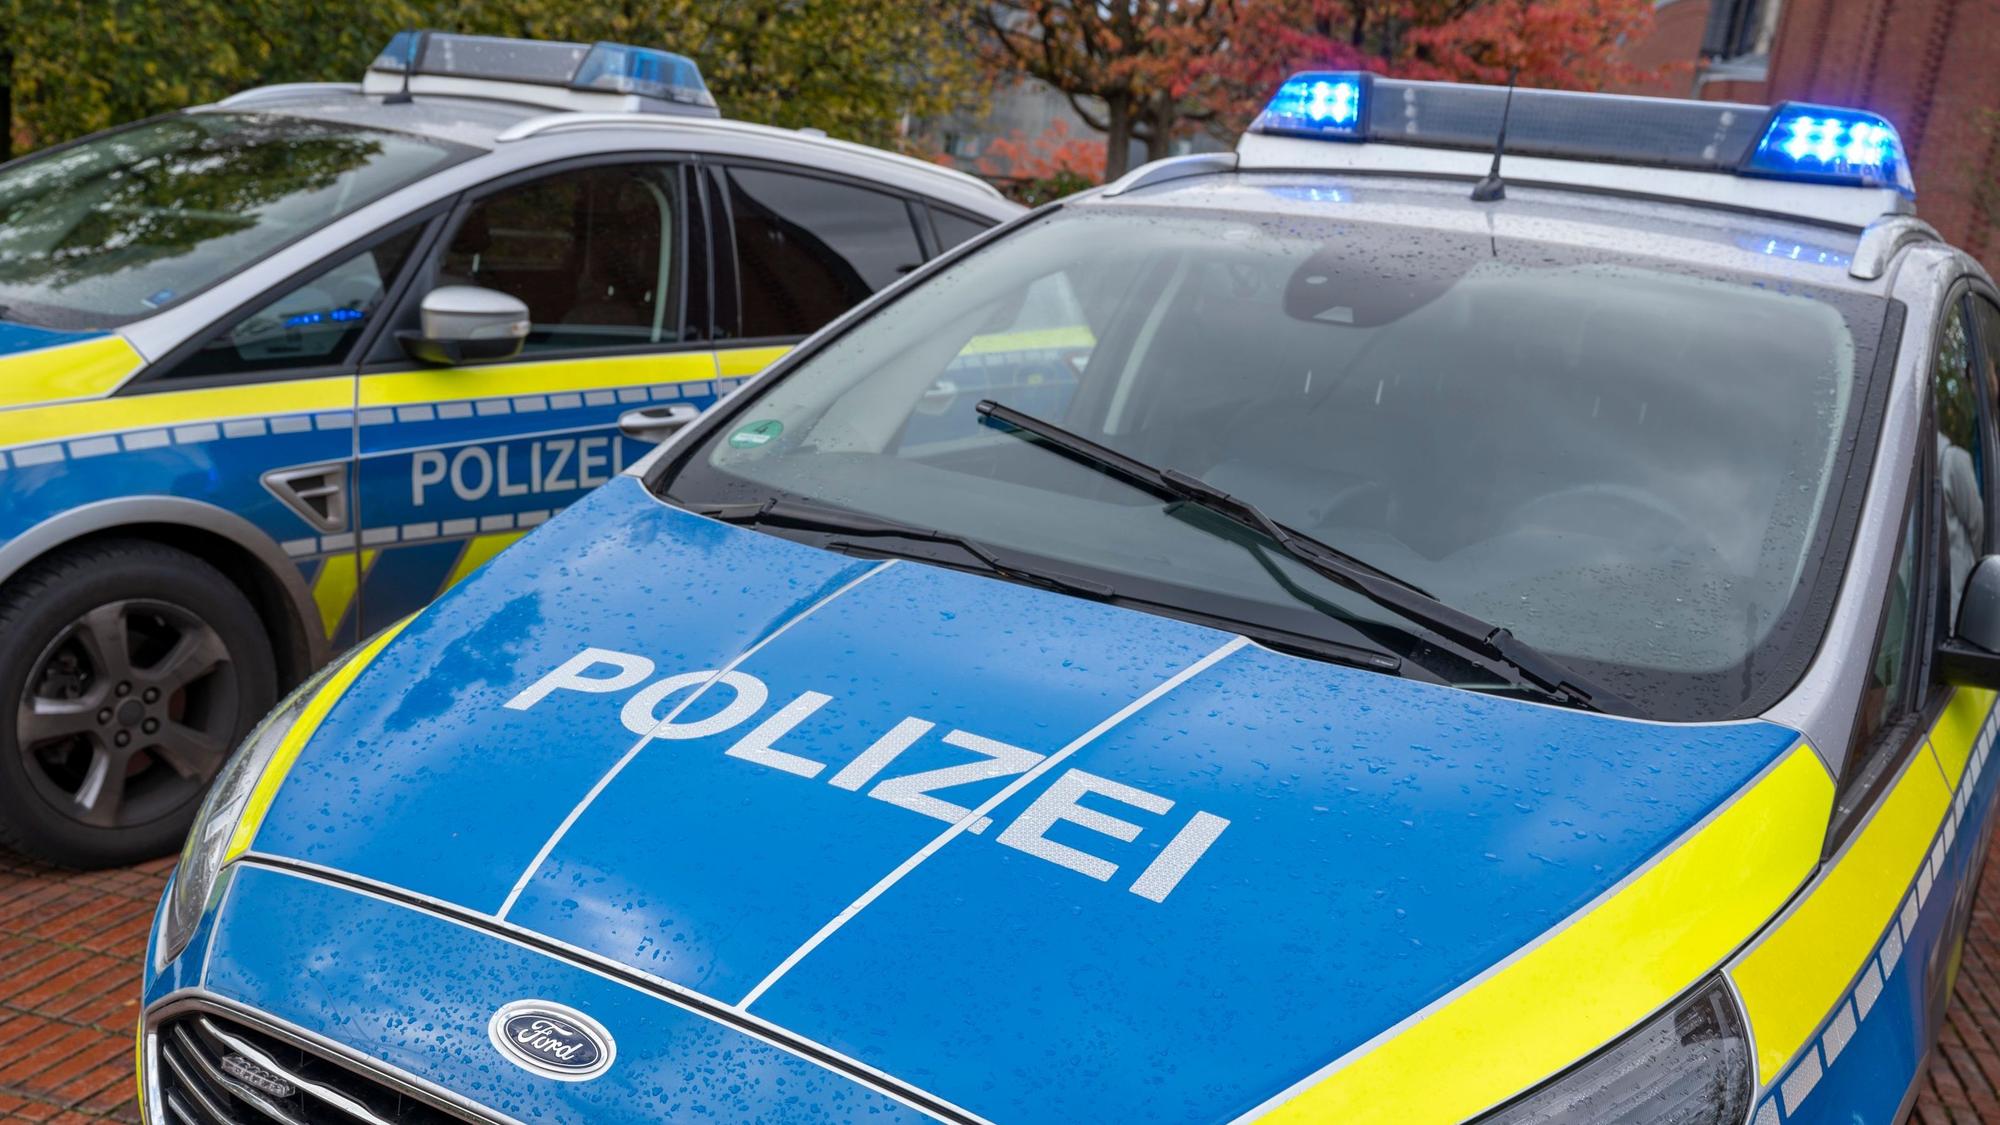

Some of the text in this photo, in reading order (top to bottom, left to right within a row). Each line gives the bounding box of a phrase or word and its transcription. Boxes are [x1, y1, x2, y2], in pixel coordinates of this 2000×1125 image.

[412, 436, 623, 506] POLIZEI
[503, 647, 1231, 903] POLIZEI
[517, 1020, 584, 1061] Ford
